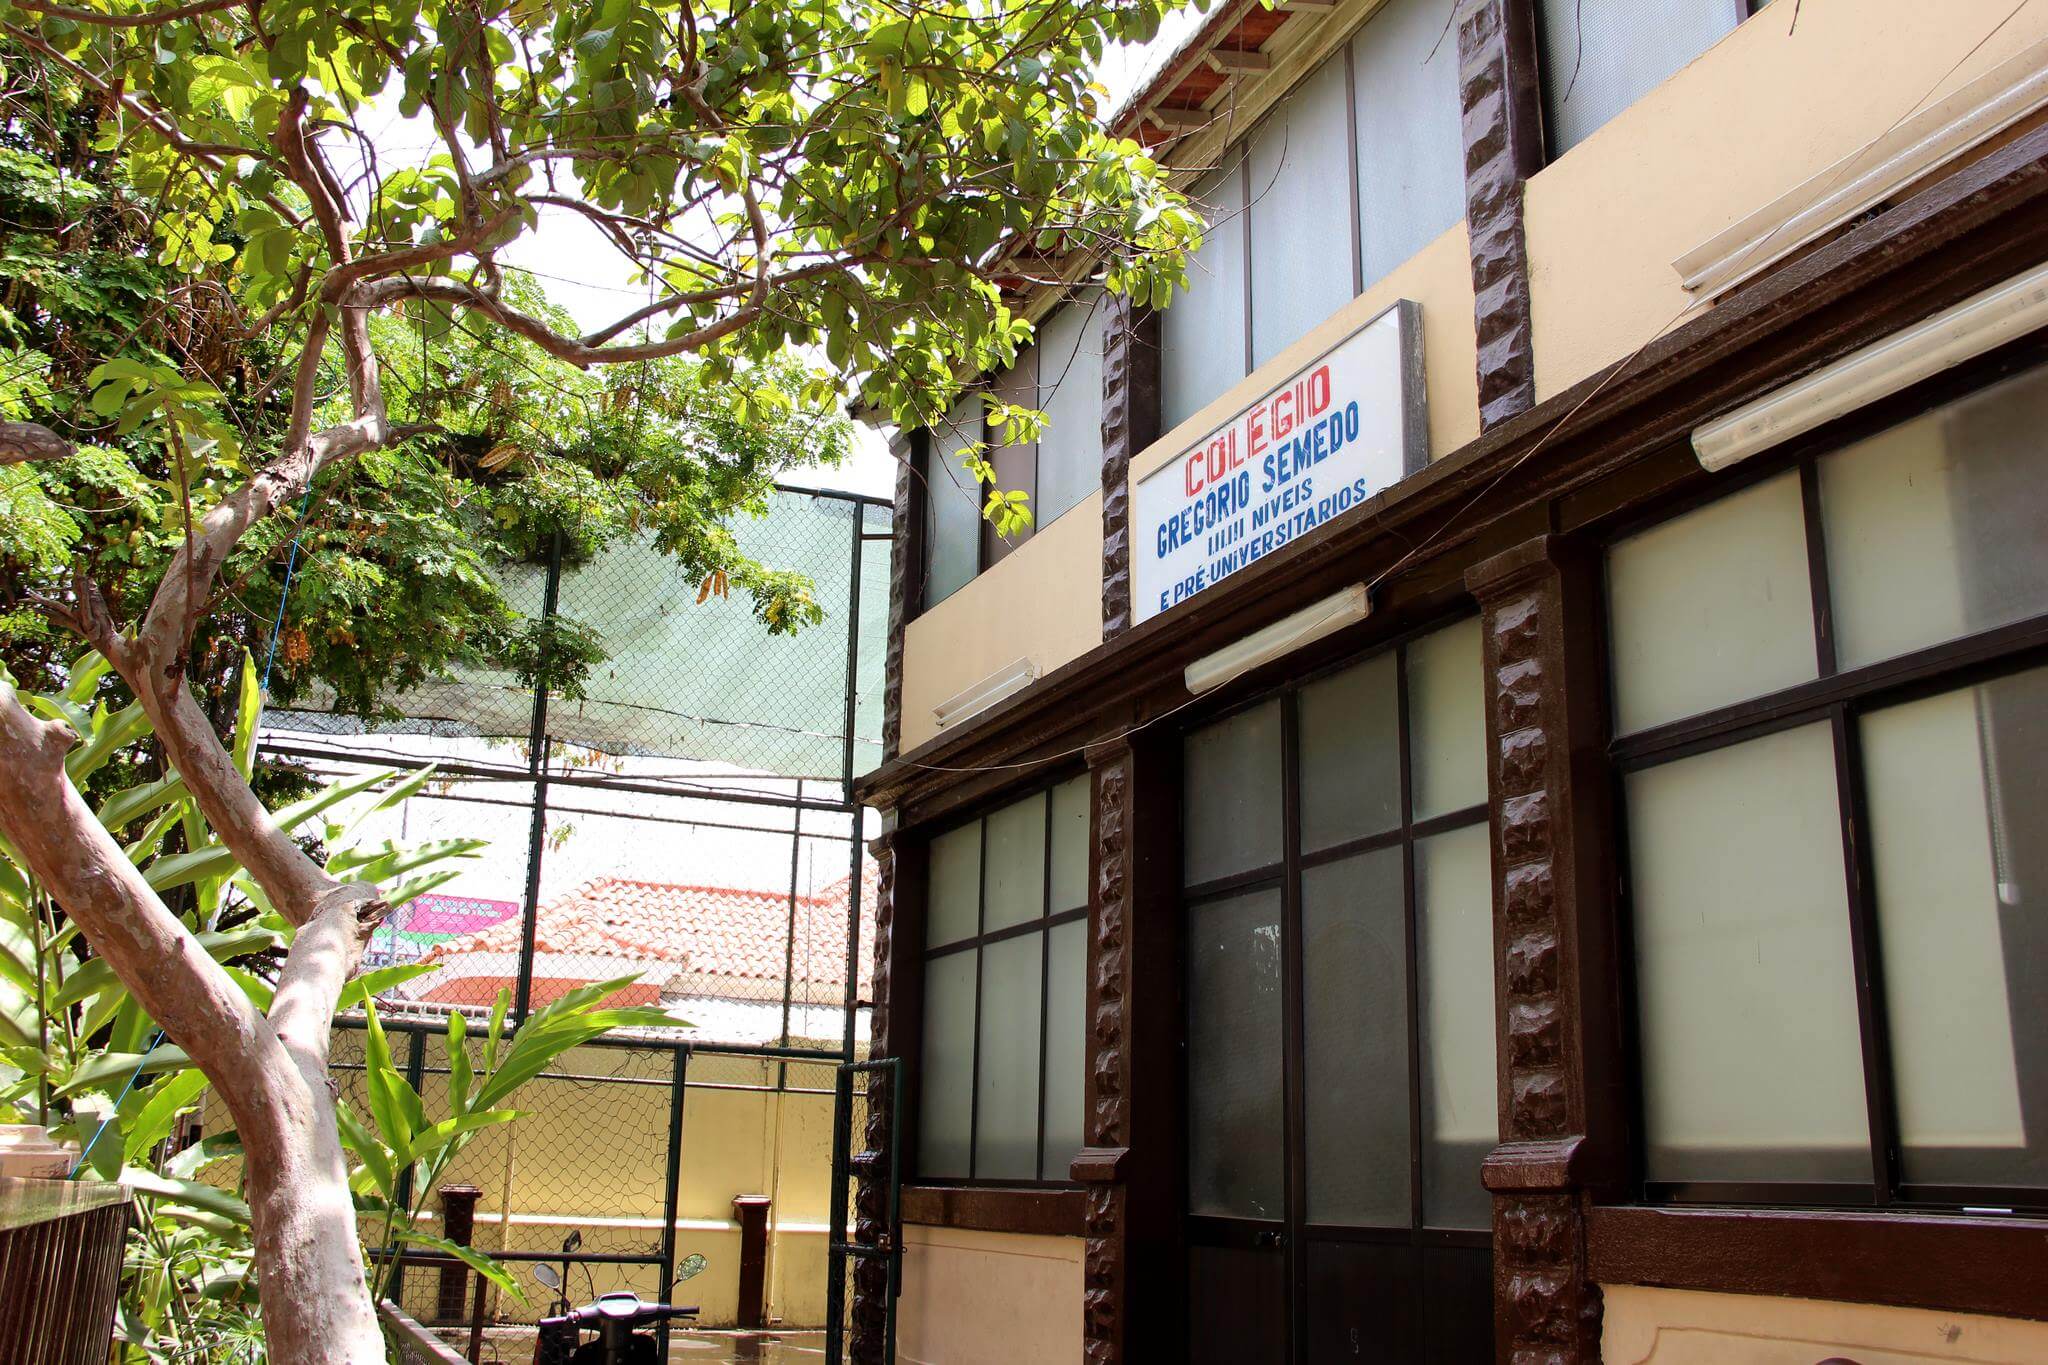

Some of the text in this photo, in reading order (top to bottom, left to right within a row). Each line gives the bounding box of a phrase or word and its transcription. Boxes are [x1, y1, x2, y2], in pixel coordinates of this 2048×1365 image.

[1157, 401, 1359, 559] GREGÓRIO SEMEDO
[1252, 477, 1312, 530] NÍVEIS
[1160, 589, 1170, 611] E
